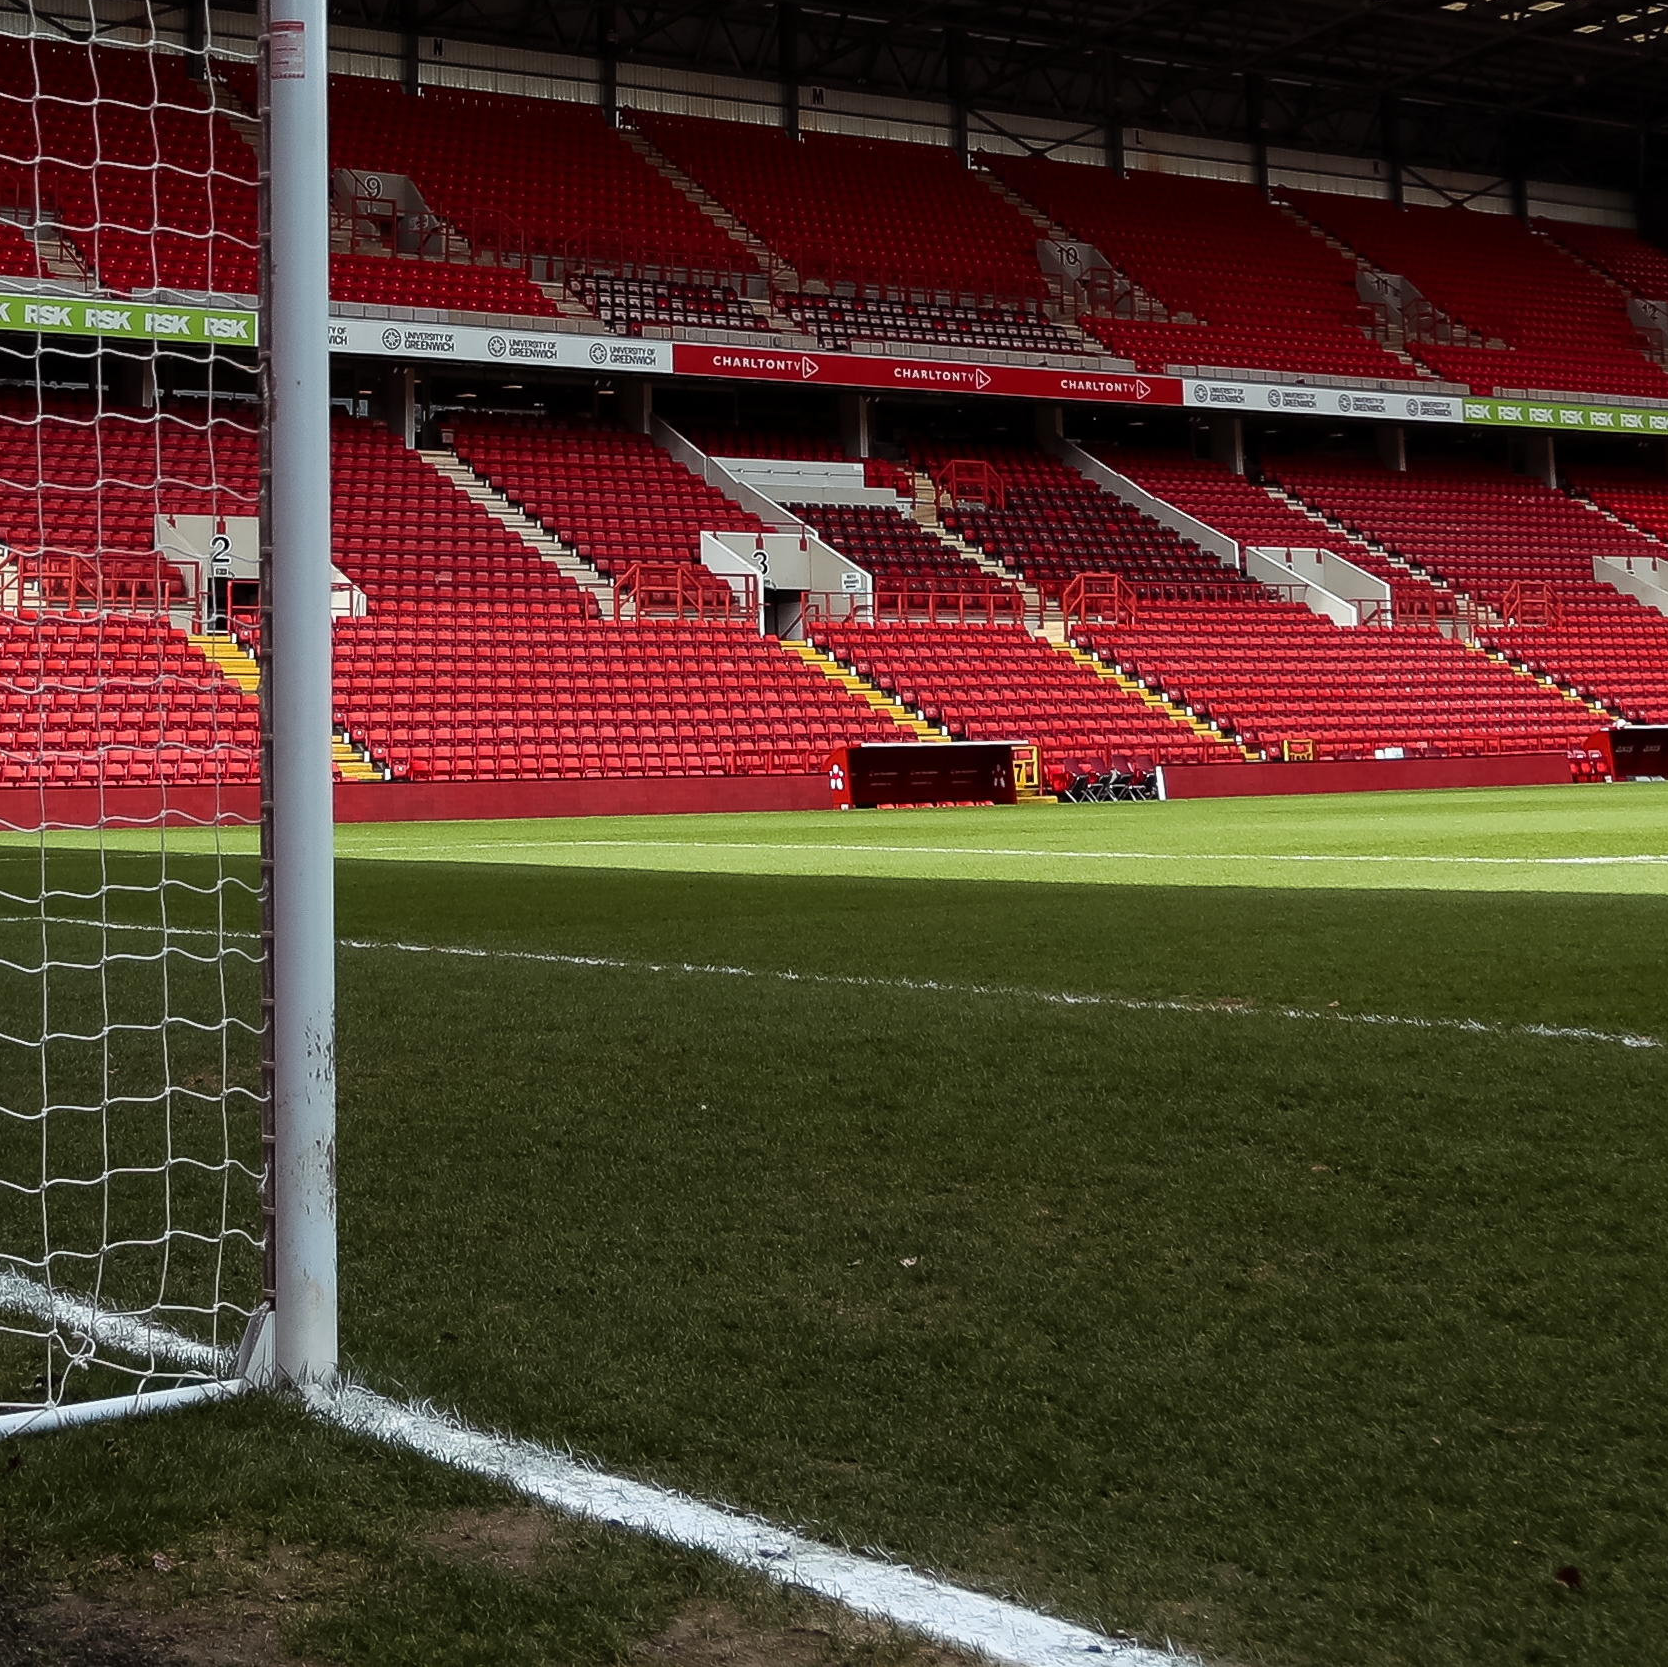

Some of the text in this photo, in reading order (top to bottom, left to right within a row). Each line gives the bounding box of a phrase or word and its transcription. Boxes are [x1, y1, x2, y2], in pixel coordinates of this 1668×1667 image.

[434, 38, 443, 56] N
[812, 87, 824, 105] M
[1135, 130, 1142, 145] L
[364, 175, 382, 199] 9
[1056, 246, 1078, 266] 10
[24, 305, 72, 327] RSK
[85, 309, 132, 330] RSK
[145, 312, 191, 335] RSK
[204, 317, 249, 339] RSK
[404, 331, 454, 342] UNIVERSITY OF
[509, 339, 557, 351] UNIVERSITY OF
[404, 340, 455, 352] GREENWICH
[509, 347, 558, 360] GREENWICH
[610, 346, 656, 358] UNIVERSITY OF
[610, 354, 656, 366] GREENWICH
[1465, 404, 1491, 420] RSK
[1498, 406, 1523, 421] RSK
[1529, 407, 1554, 423] RSK
[1559, 409, 1584, 424] RSK
[1590, 411, 1614, 427] RSK
[1620, 413, 1644, 428] RSK
[211, 536, 231, 563] 2
[753, 551, 768, 574] 3
